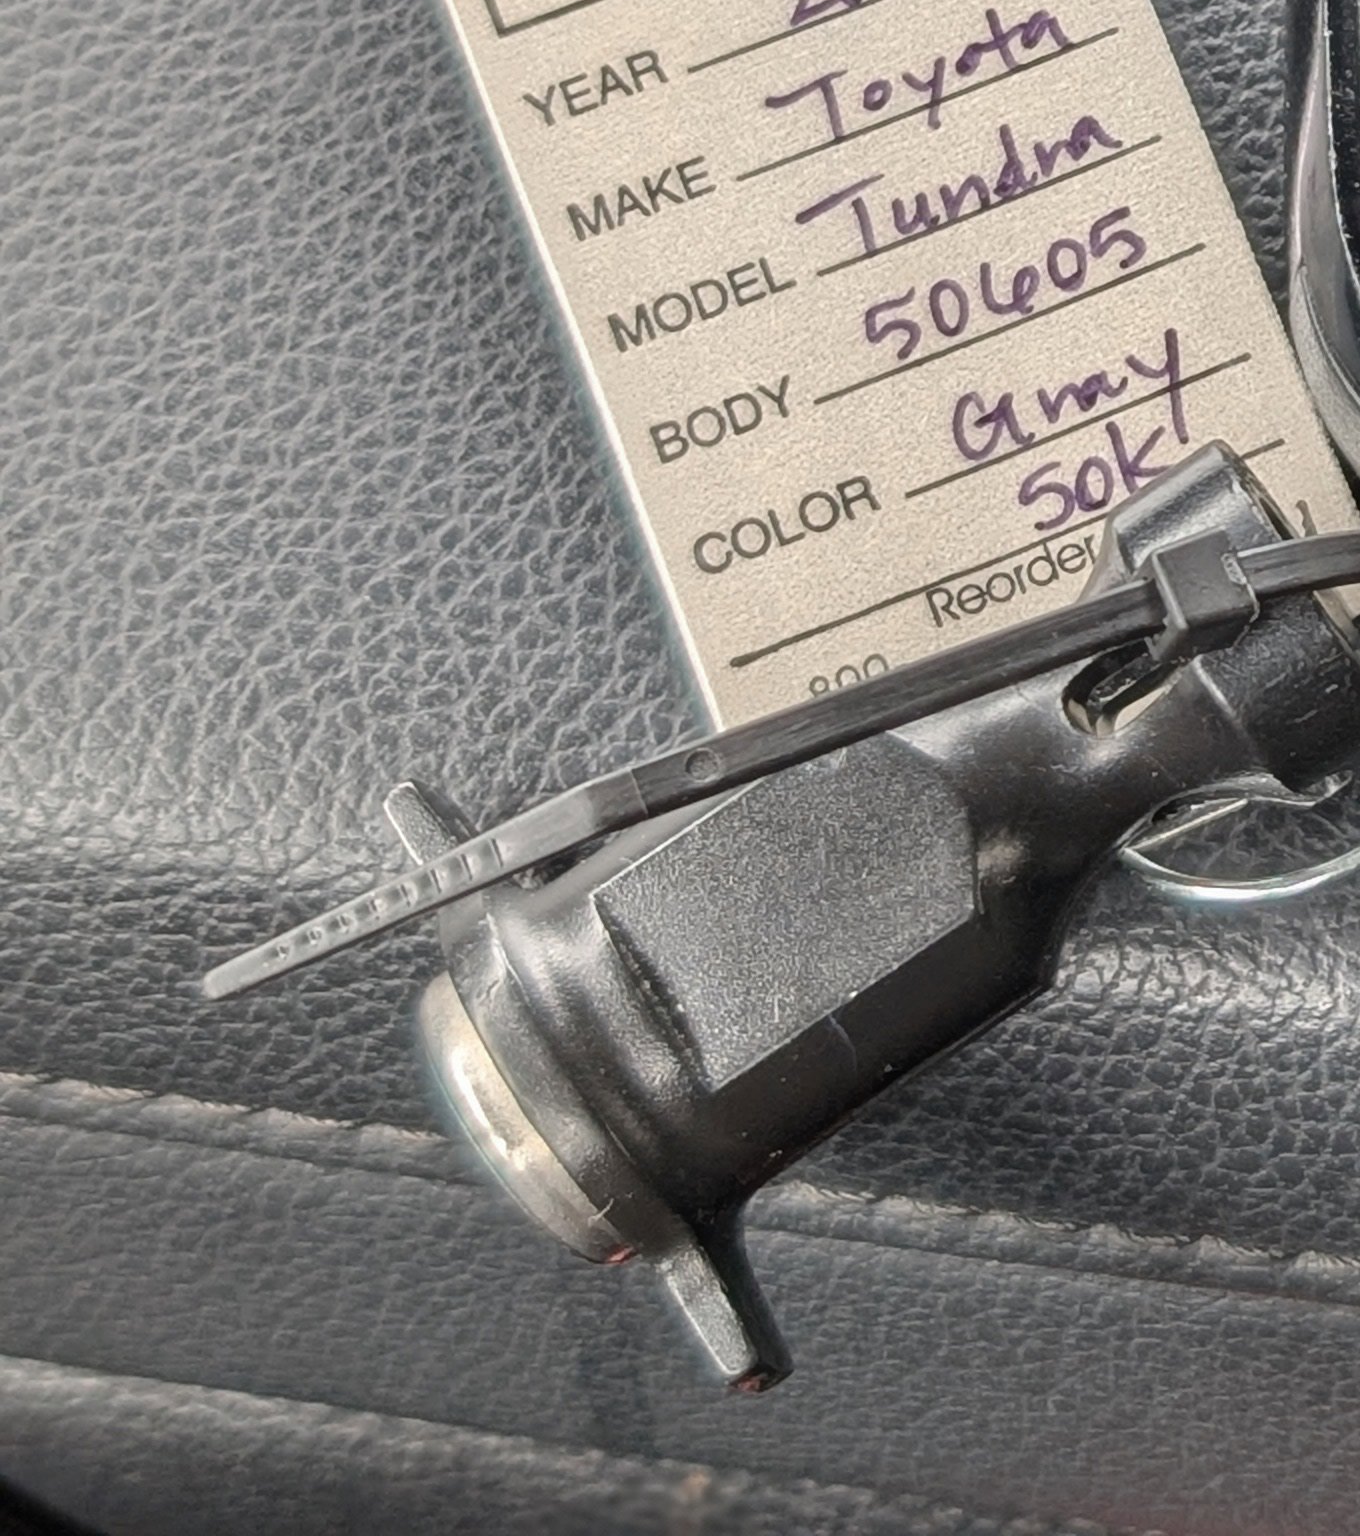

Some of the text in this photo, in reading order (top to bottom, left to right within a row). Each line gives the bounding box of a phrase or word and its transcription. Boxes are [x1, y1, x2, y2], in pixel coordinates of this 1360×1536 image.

[522, 48, 669, 127] YEAR
[765, 8, 1071, 144] Toyota
[566, 156, 718, 241] MAKE
[795, 115, 1123, 256] Tundra
[607, 258, 797, 353] MODEL
[864, 208, 1148, 360] 50605
[650, 375, 792, 464] BODY
[953, 328, 1190, 462] Gray
[693, 475, 881, 573] COLOR
[925, 535, 1095, 628] Reorder
